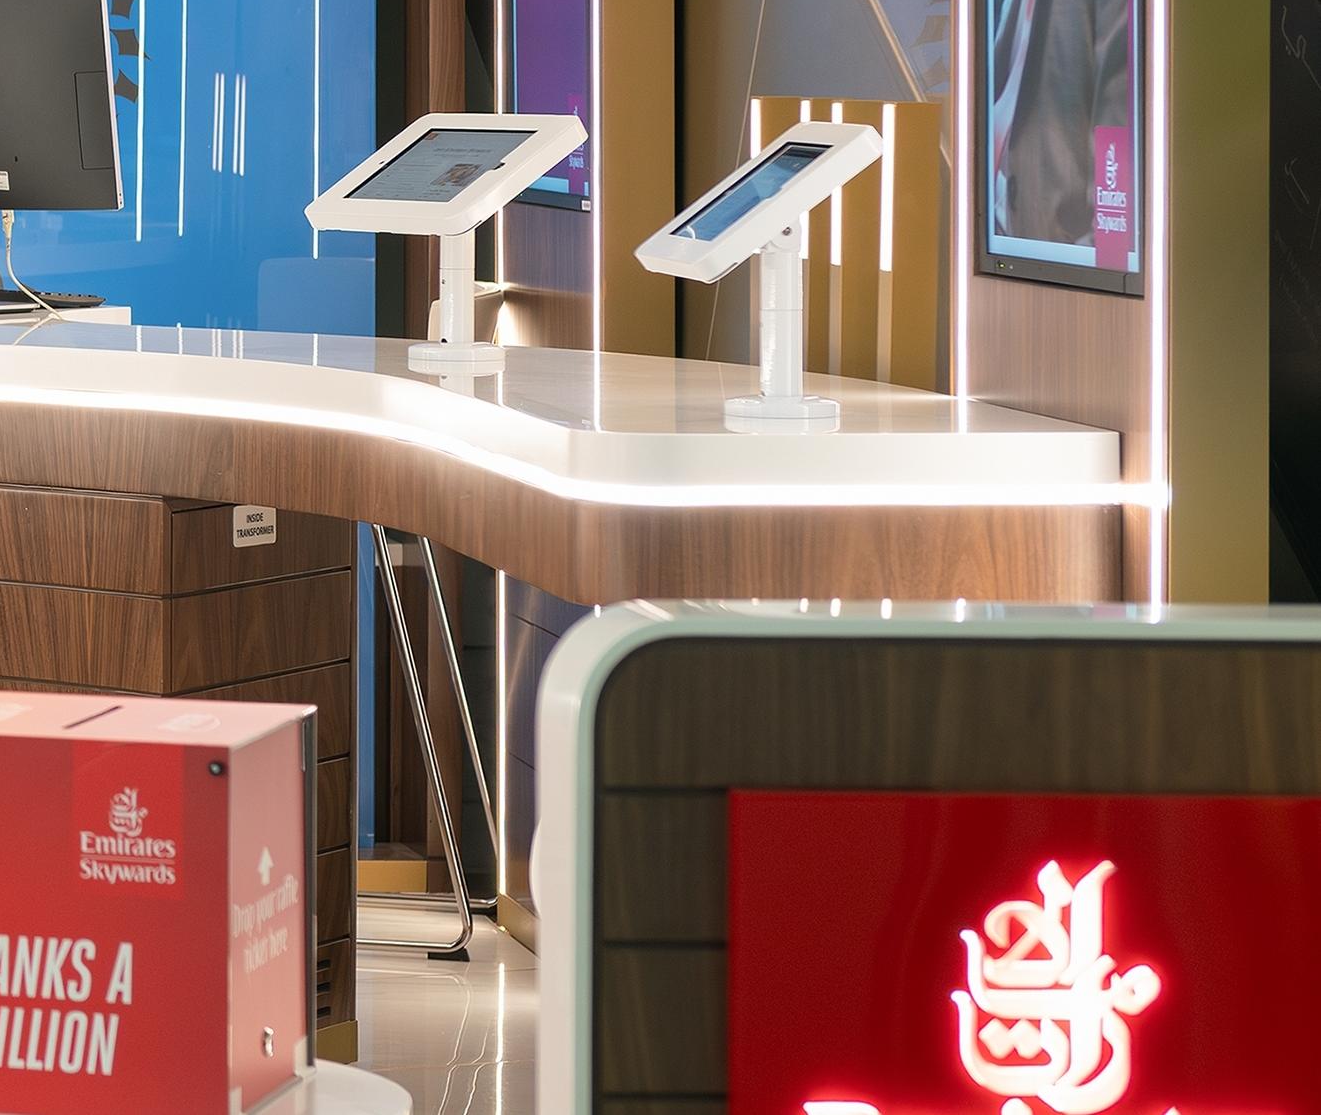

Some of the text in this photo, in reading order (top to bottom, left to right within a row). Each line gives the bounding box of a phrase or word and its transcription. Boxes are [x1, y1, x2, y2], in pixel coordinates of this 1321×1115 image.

[246, 512, 264, 523] INSIDE
[236, 525, 274, 538] TRANSFORMER
[79, 830, 176, 859] Emirates
[79, 858, 176, 885] Skywards
[106, 941, 133, 1005] A
